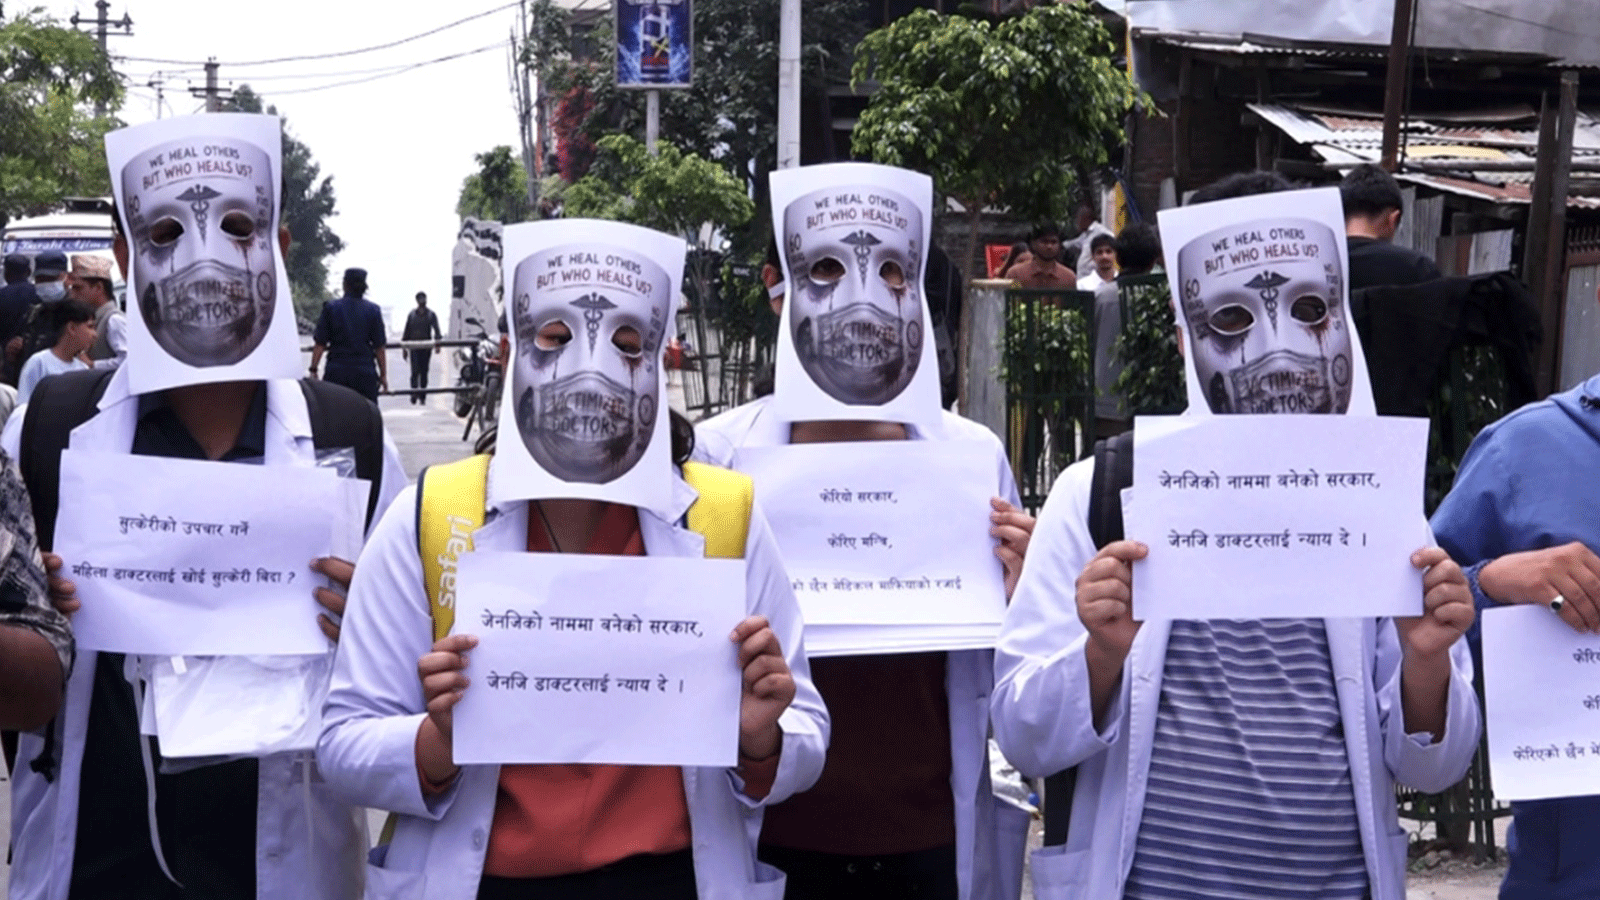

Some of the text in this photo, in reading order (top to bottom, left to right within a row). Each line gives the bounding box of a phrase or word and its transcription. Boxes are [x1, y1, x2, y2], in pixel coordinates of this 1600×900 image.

[148, 146, 240, 168] WE HEAL OTHERS
[143, 160, 253, 190] BUT WHO HEALS US?
[815, 194, 899, 212] WE HEAL OTHERS
[807, 212, 825, 229] BUT
[830, 208, 857, 221] WHO
[862, 208, 893, 225] HEALS
[1211, 228, 1305, 253] WE HEAL OTHERS
[547, 253, 641, 275] WE HEAL OTHERS
[1204, 243, 1319, 274] BUT WHO HEALS US?
[536, 268, 652, 298] BUT WHO HEALS US?
[1184, 278, 1200, 300] 60
[1159, 469, 1381, 490] जेनजिको नाममा बनेको सरकार,
[857, 491, 898, 504] सरकार,
[119, 513, 177, 535] सुत्केरीको
[182, 521, 224, 536] उपचार
[1168, 529, 1209, 548] जेनजि
[1215, 529, 1292, 549] डाक्टरलाई
[1298, 533, 1333, 547] न्याय
[1338, 527, 1350, 548] दे
[72, 560, 108, 580] महिला
[113, 567, 176, 583] डाक्टरलाई
[212, 567, 251, 588] सुत्केरी
[437, 515, 473, 611] safari
[481, 609, 704, 638] जेनजिको नाममा बनेको सरकार,
[487, 671, 529, 690] जेनजि
[534, 673, 611, 693] डाक्टरलाई
[616, 677, 650, 692] न्याय
[657, 674, 669, 693] दे
